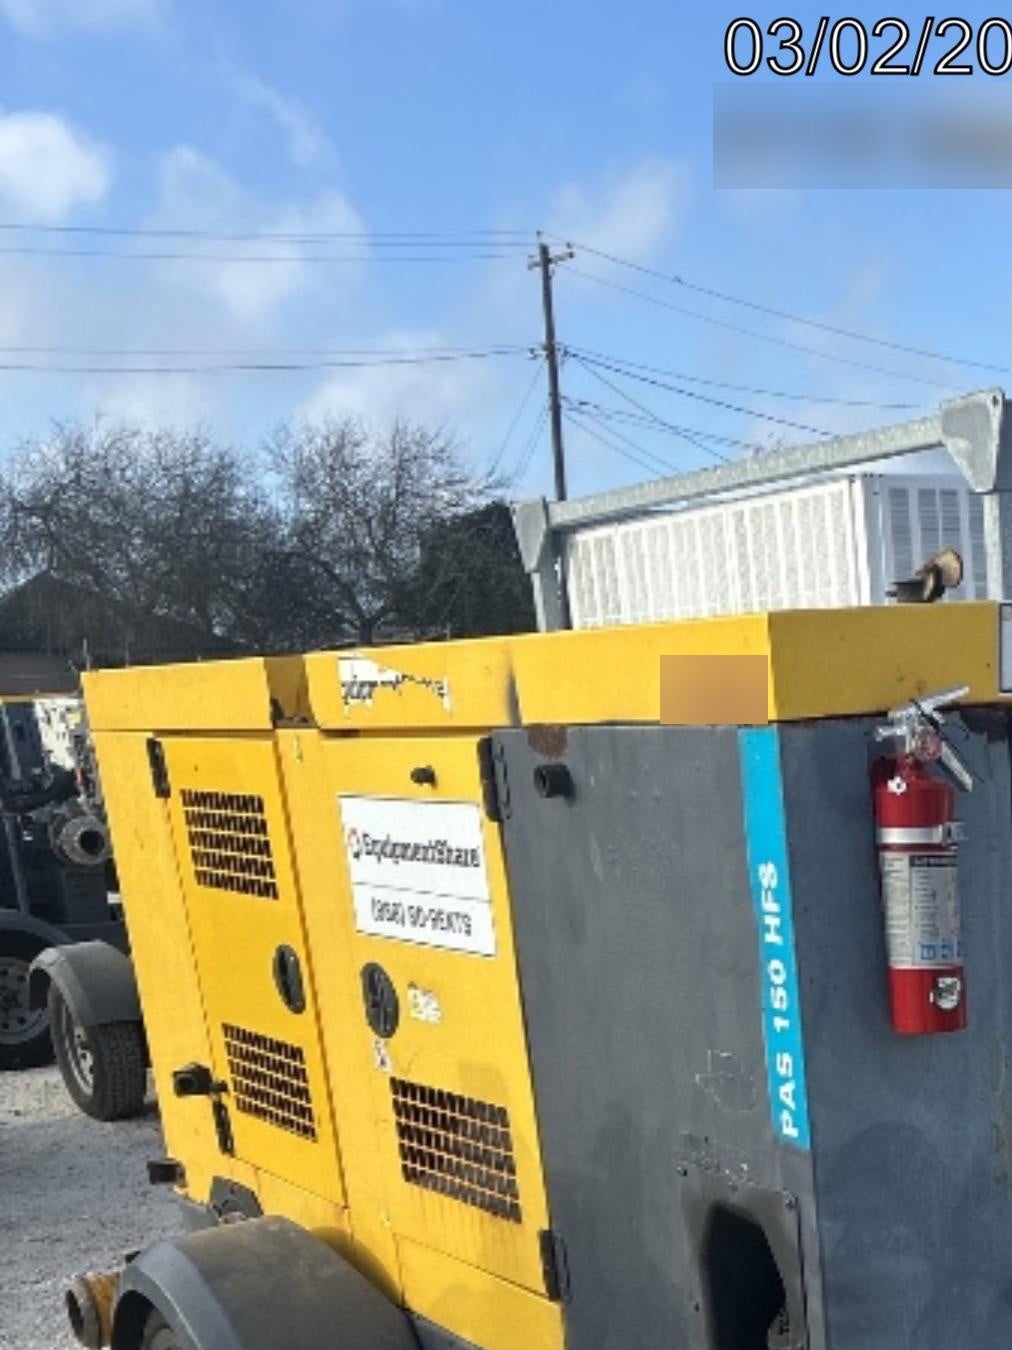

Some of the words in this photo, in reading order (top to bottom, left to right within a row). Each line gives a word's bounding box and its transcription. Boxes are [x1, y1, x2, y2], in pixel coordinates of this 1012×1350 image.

[758, 861, 784, 945] HFS
[767, 959, 791, 1032] 150
[776, 1051, 799, 1138] PAS
